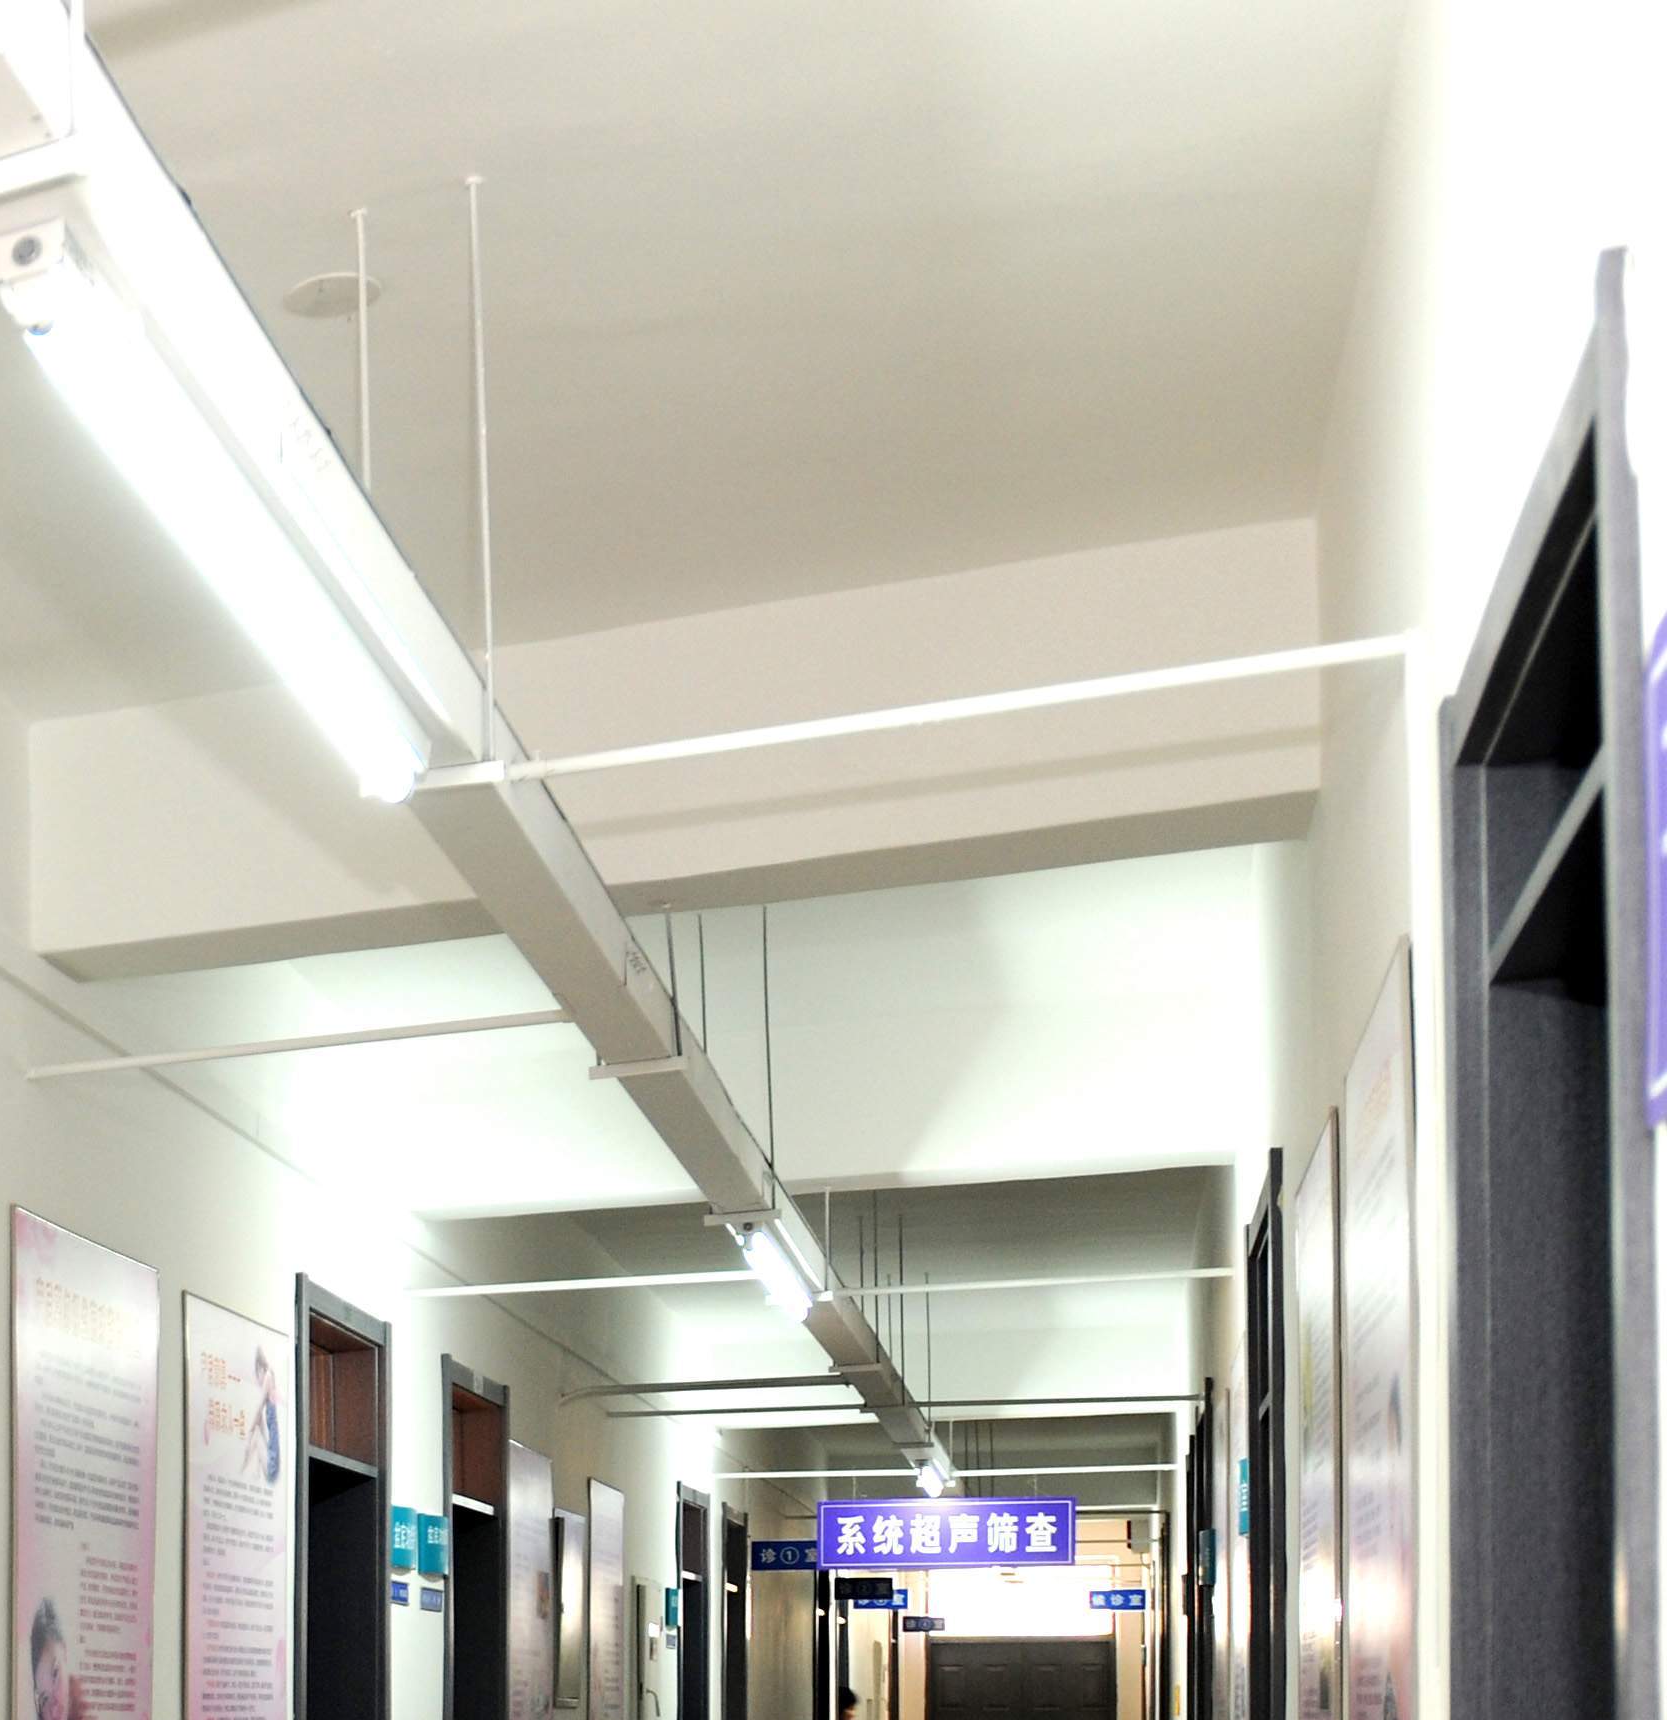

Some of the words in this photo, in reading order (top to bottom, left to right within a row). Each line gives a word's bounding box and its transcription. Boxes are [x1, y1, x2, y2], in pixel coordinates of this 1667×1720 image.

[836, 1511, 1058, 1556] 系统超声筛查
